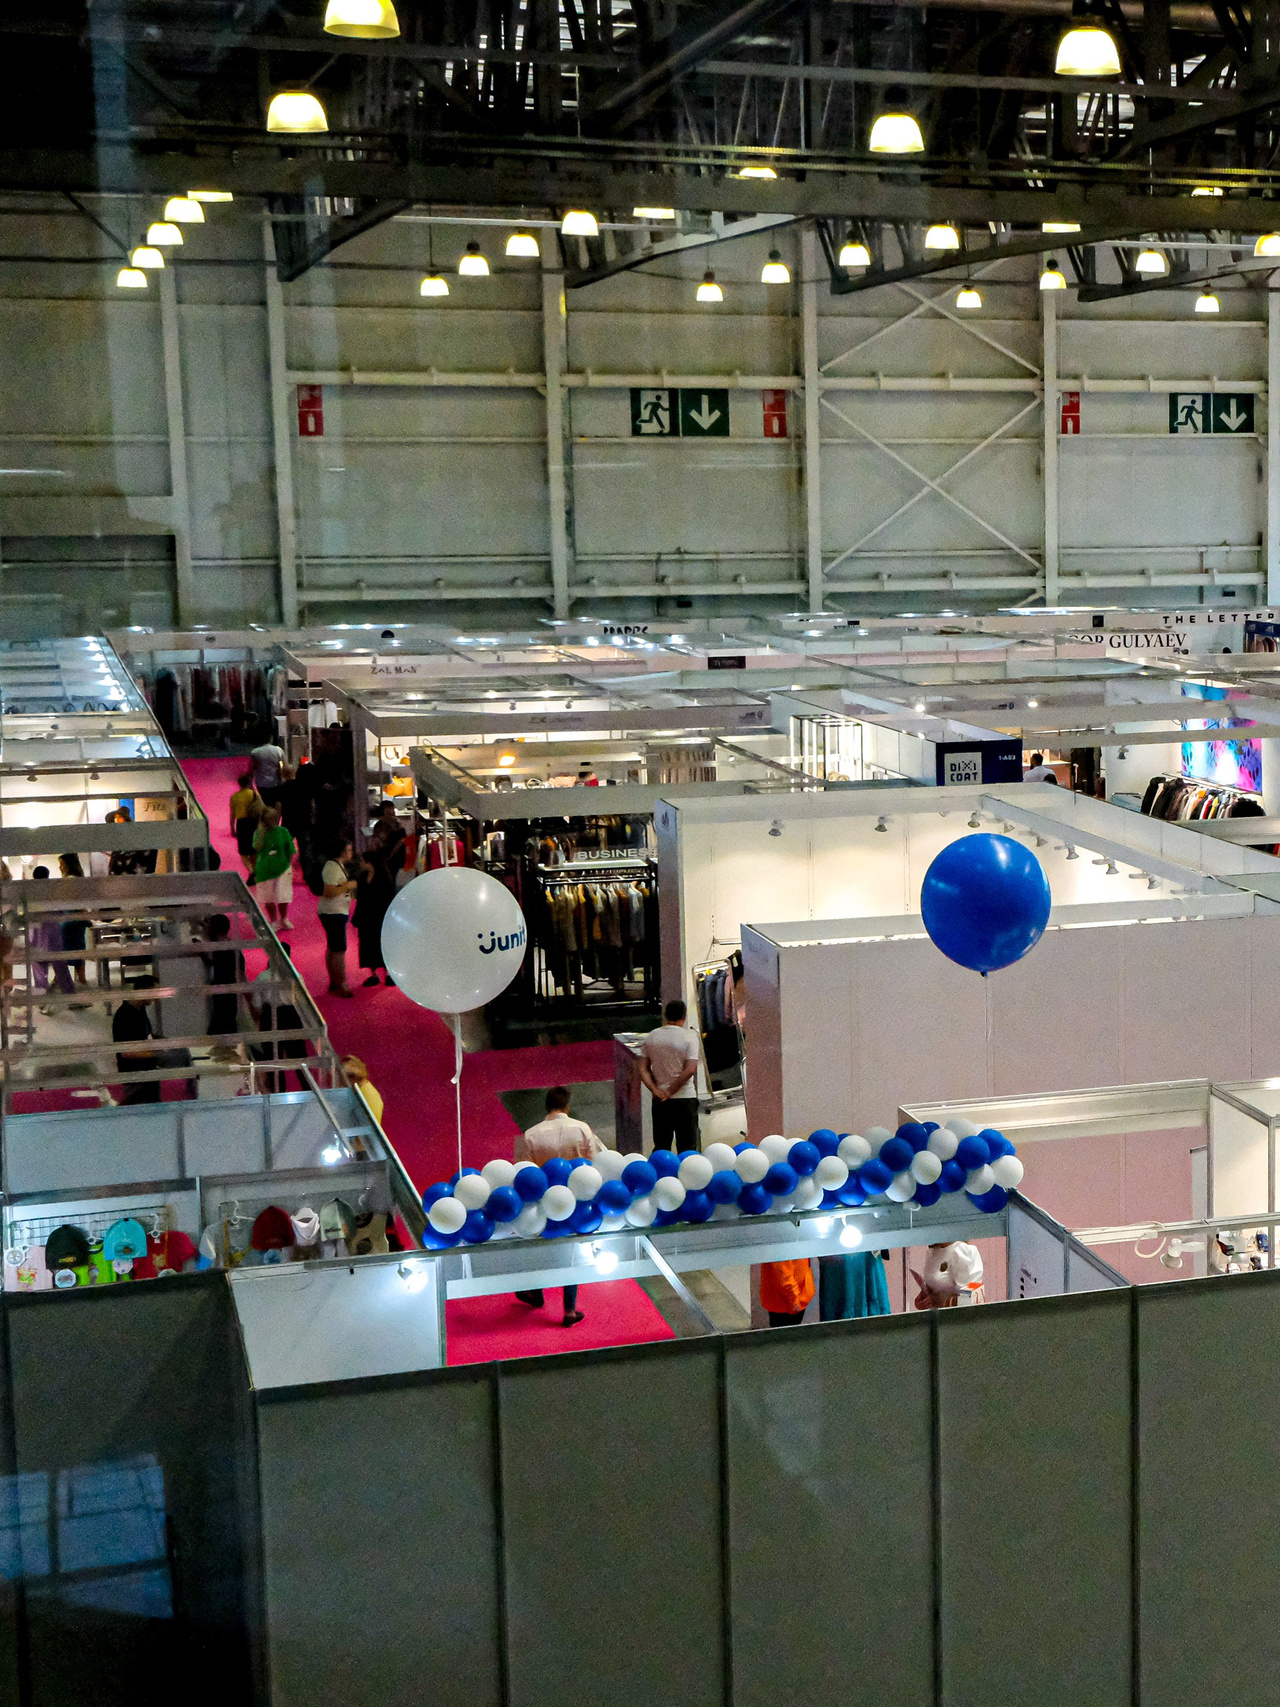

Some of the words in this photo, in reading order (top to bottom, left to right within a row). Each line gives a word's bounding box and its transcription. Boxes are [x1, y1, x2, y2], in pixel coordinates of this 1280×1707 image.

[1163, 615, 1196, 624] THE
[1109, 633, 1187, 648] GULYAEV
[950, 761, 977, 772] DIXI
[950, 772, 978, 782] COAT
